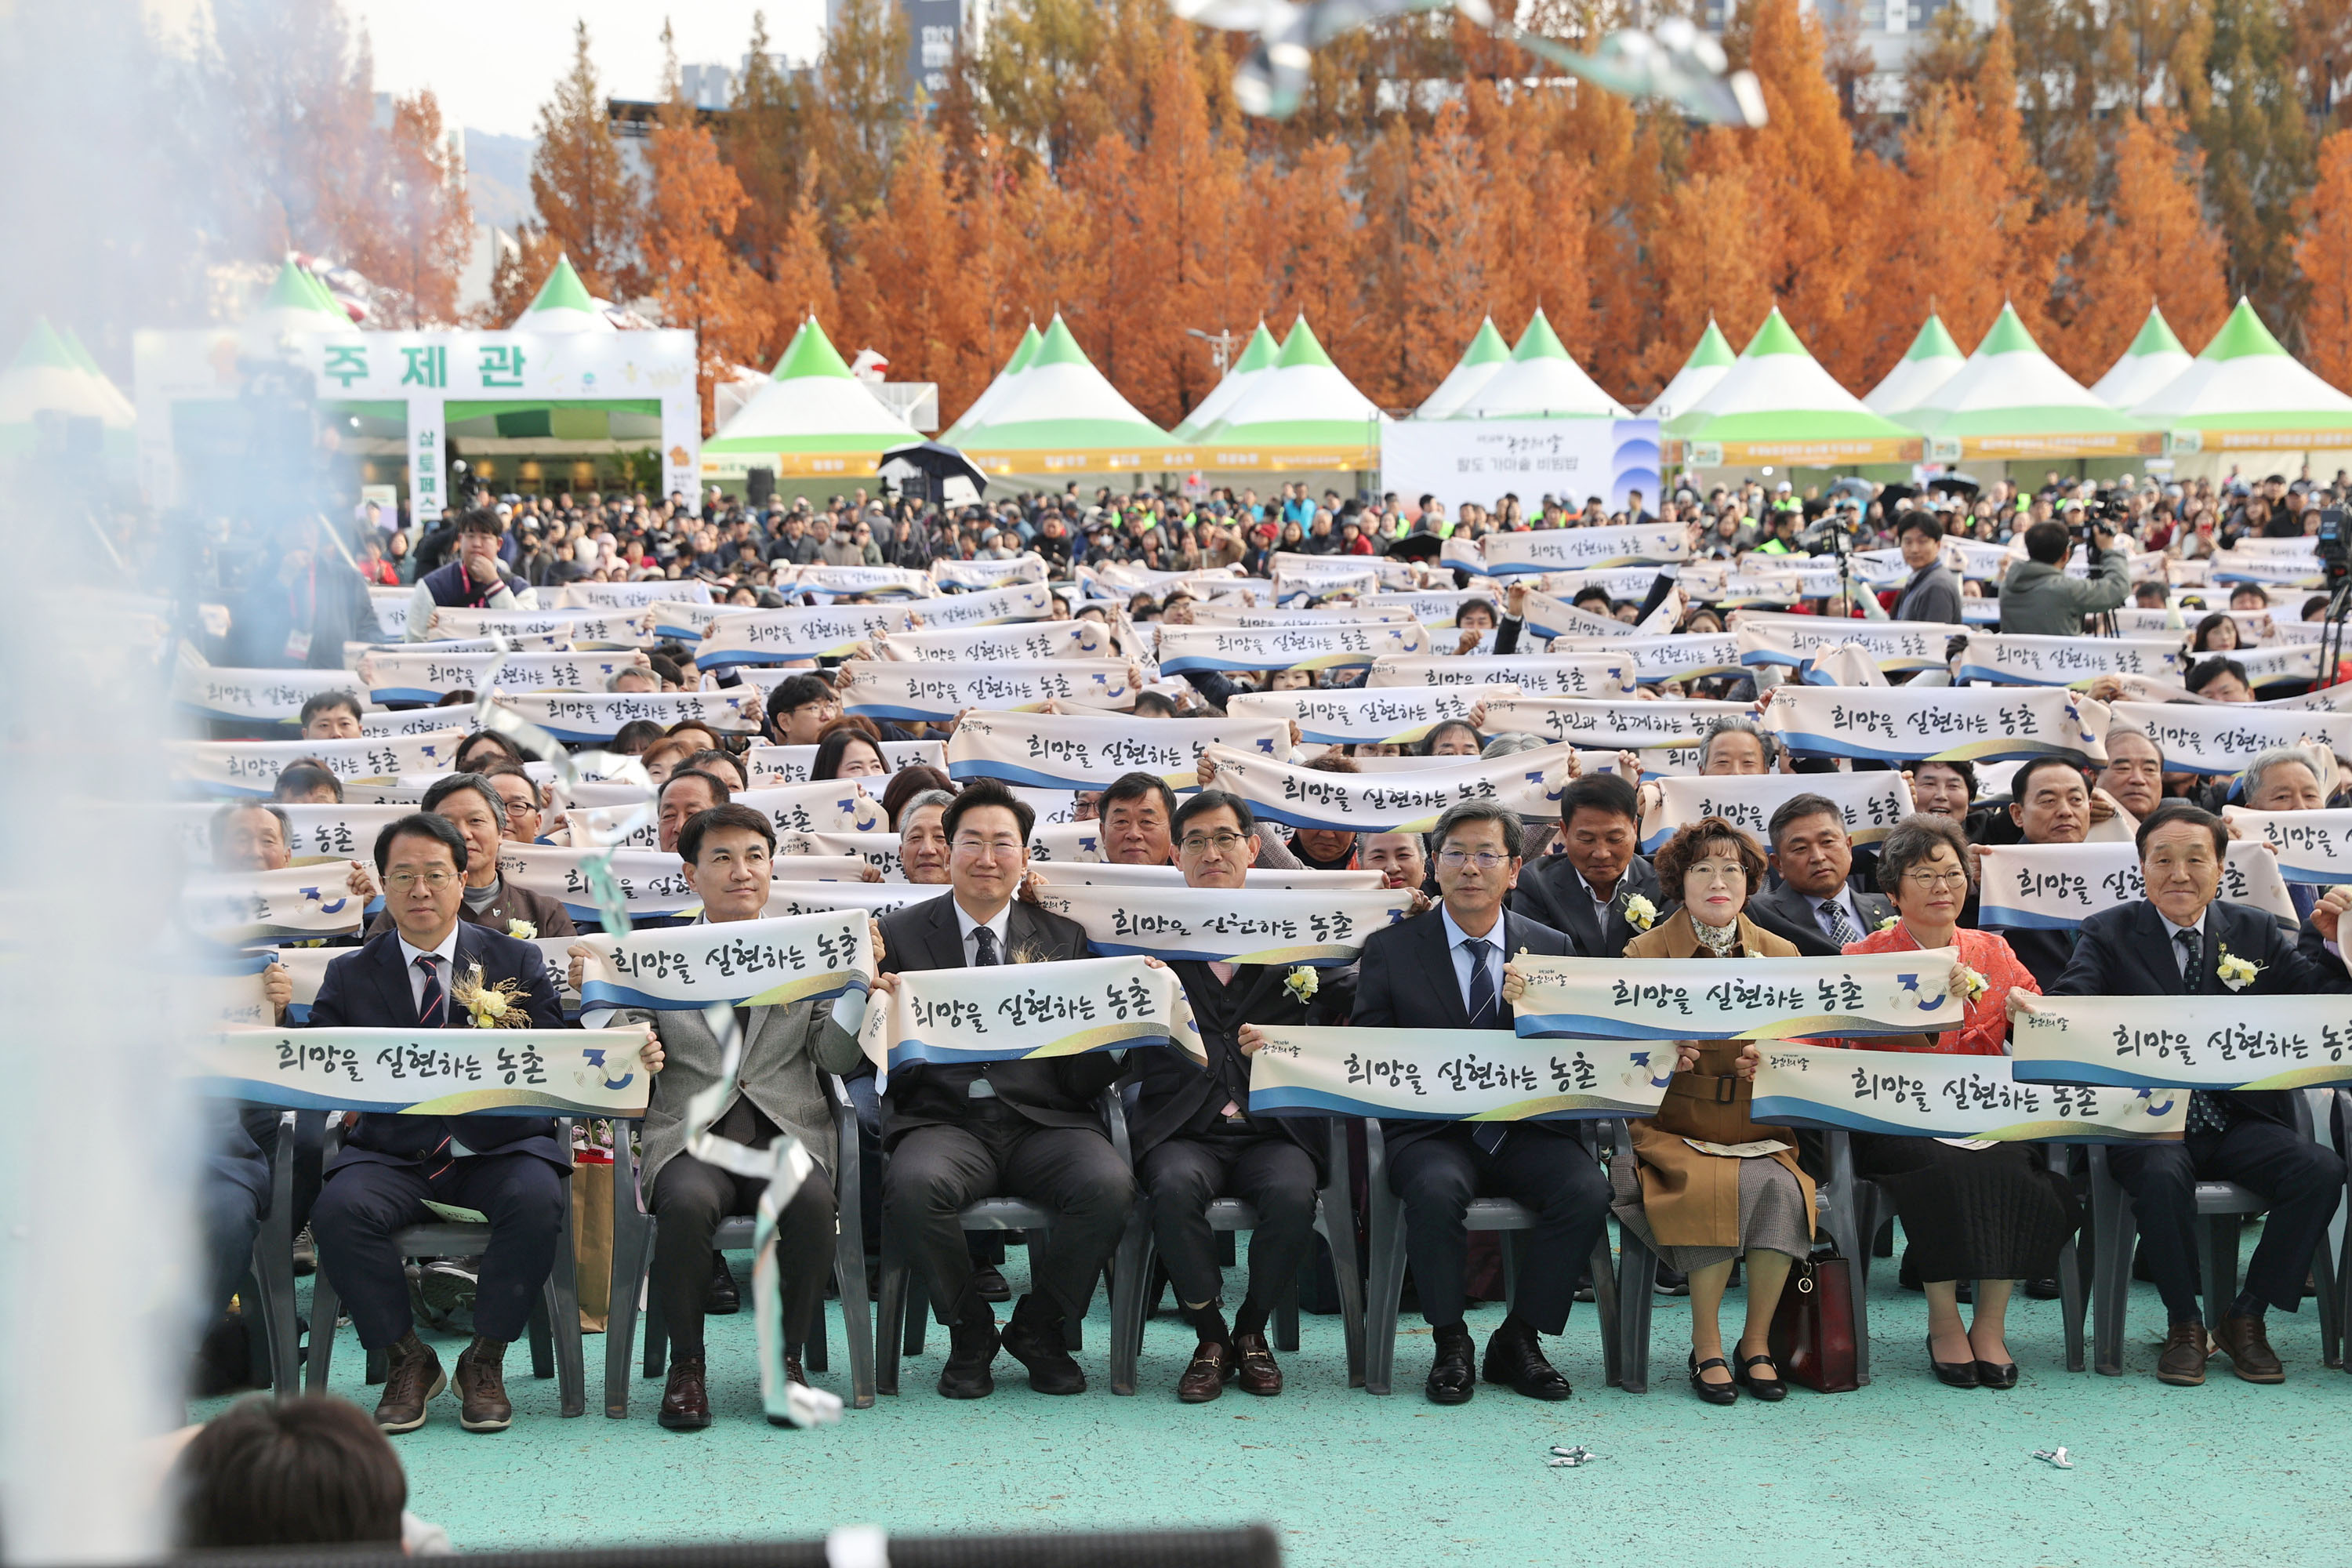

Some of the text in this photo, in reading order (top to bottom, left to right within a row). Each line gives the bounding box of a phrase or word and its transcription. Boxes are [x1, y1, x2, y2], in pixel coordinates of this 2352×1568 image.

[324, 345, 525, 388] 주제관
[1529, 543, 1566, 560] 희망을
[1571, 540, 1615, 557] 실현하는
[585, 620, 610, 638] 농촌
[942, 607, 985, 622] 실현하는
[746, 624, 796, 644] 희망을
[800, 618, 856, 640] 실현하는
[1216, 629, 1370, 655] 희망을 실현하는 농촌
[1900, 633, 1927, 655] 농촌
[965, 640, 1021, 661] 실현하는
[1025, 633, 1054, 657] 농촌
[1651, 643, 1739, 664] 실현하는 농촌
[1996, 644, 2143, 673] 희망을 실현하는 농촌
[427, 664, 477, 688] 희망을
[552, 662, 582, 686] 농촌
[906, 673, 1073, 704] 희망을 실현하는 농촌
[1556, 669, 1588, 692] 농촌
[546, 698, 706, 723] 희망을 실현하는 농촌
[1296, 695, 1469, 726] 희망을 실현하는 농촌
[1546, 710, 1682, 739] 국민과 함께하는
[1831, 704, 2038, 739] 희망을 실현하는 농촌
[1027, 734, 1182, 769] 희망을 실현하는
[2145, 720, 2205, 756] 희망을
[367, 746, 401, 775] 농촌
[1282, 775, 1352, 812] 희망을
[1363, 786, 1448, 810] 실현하는
[1867, 790, 1902, 826] 농촌
[314, 821, 356, 852] 농촌
[2263, 821, 2338, 858] 희망을
[2017, 868, 2092, 906] 희망을
[1309, 909, 1354, 944] 농촌
[609, 925, 858, 985] 희망을 실현하는 농촌
[1555, 974, 1567, 986] 날
[911, 976, 1156, 1034] 희망을 실현하는 농촌
[1611, 976, 1866, 1016] 희망을 실현하는 농촌
[2057, 1018, 2069, 1031] 날
[1289, 1045, 1301, 1058] 날
[2112, 1022, 2351, 1066] 희망을 실현하는 농
[274, 1037, 549, 1087] 희망을 실현하는 농촌
[1343, 1050, 1598, 1096] 희망을 실현하는 농촌
[1798, 1058, 1809, 1071] 날
[1850, 1067, 1932, 1113] 희망을
[1941, 1073, 2040, 1113] 실현하는
